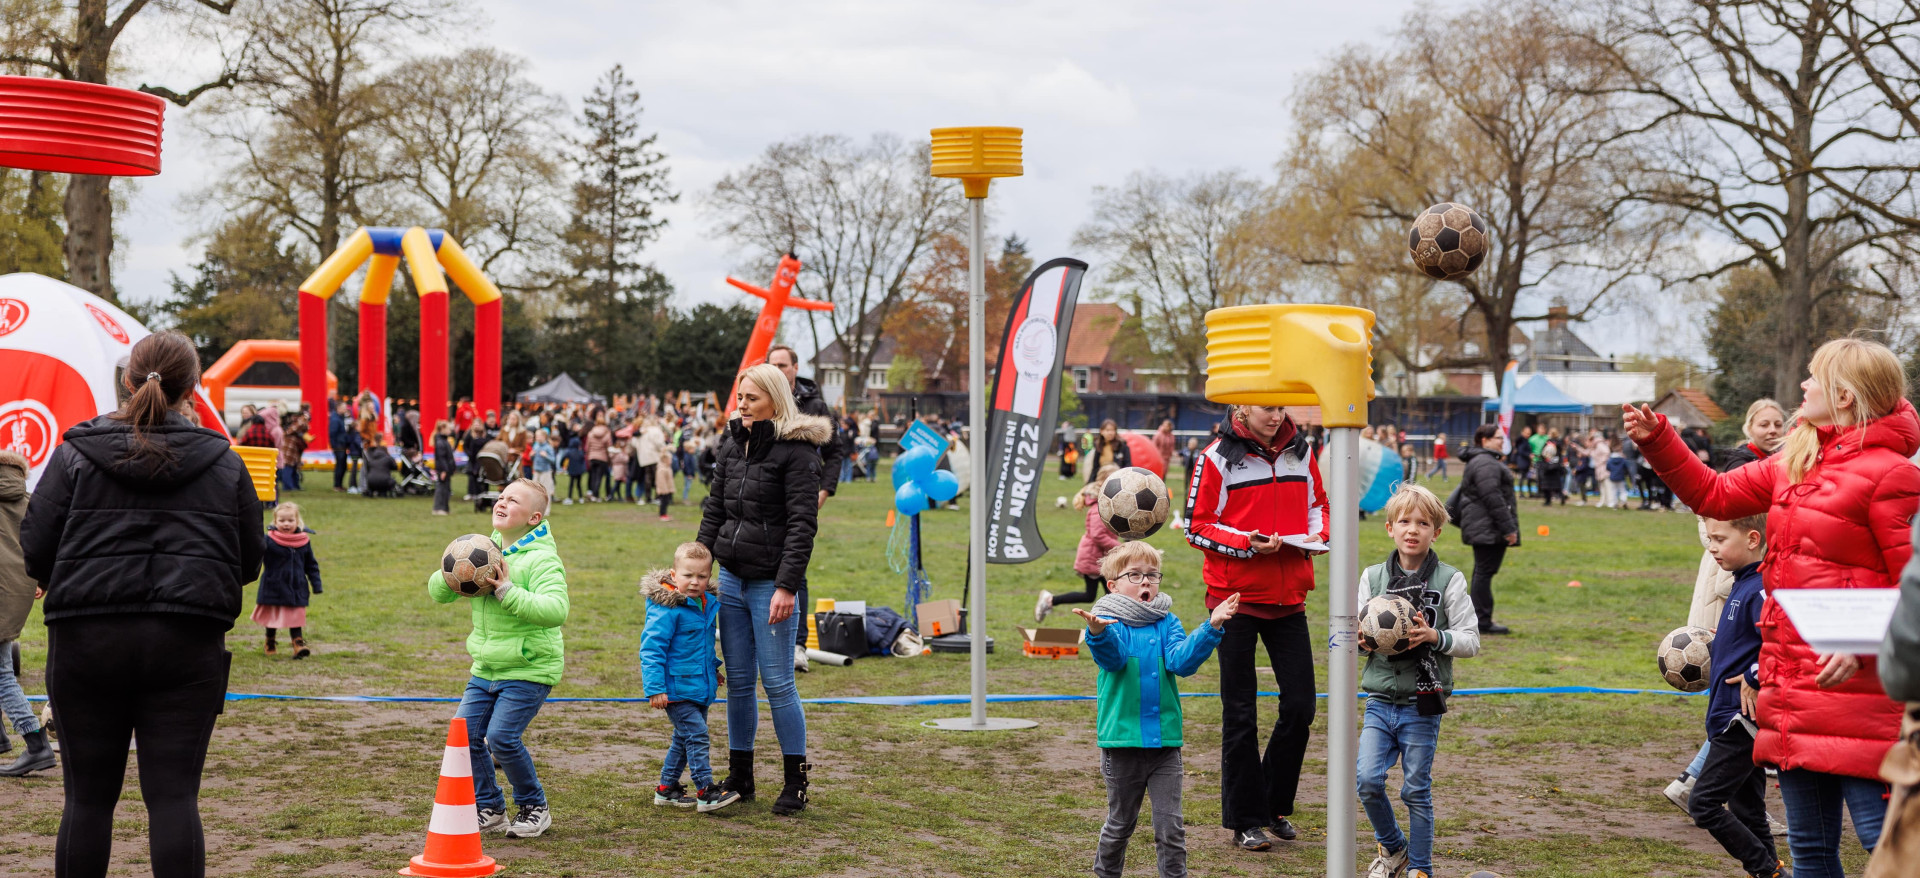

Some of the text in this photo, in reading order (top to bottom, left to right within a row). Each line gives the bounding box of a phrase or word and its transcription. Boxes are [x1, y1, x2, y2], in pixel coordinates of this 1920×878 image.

[988, 420, 1017, 557] KOM KORFBALLEN!
[1003, 424, 1039, 558] BIJ NRC'22
[1394, 601, 1408, 636] MIKASA
[1727, 600, 1740, 620] T
